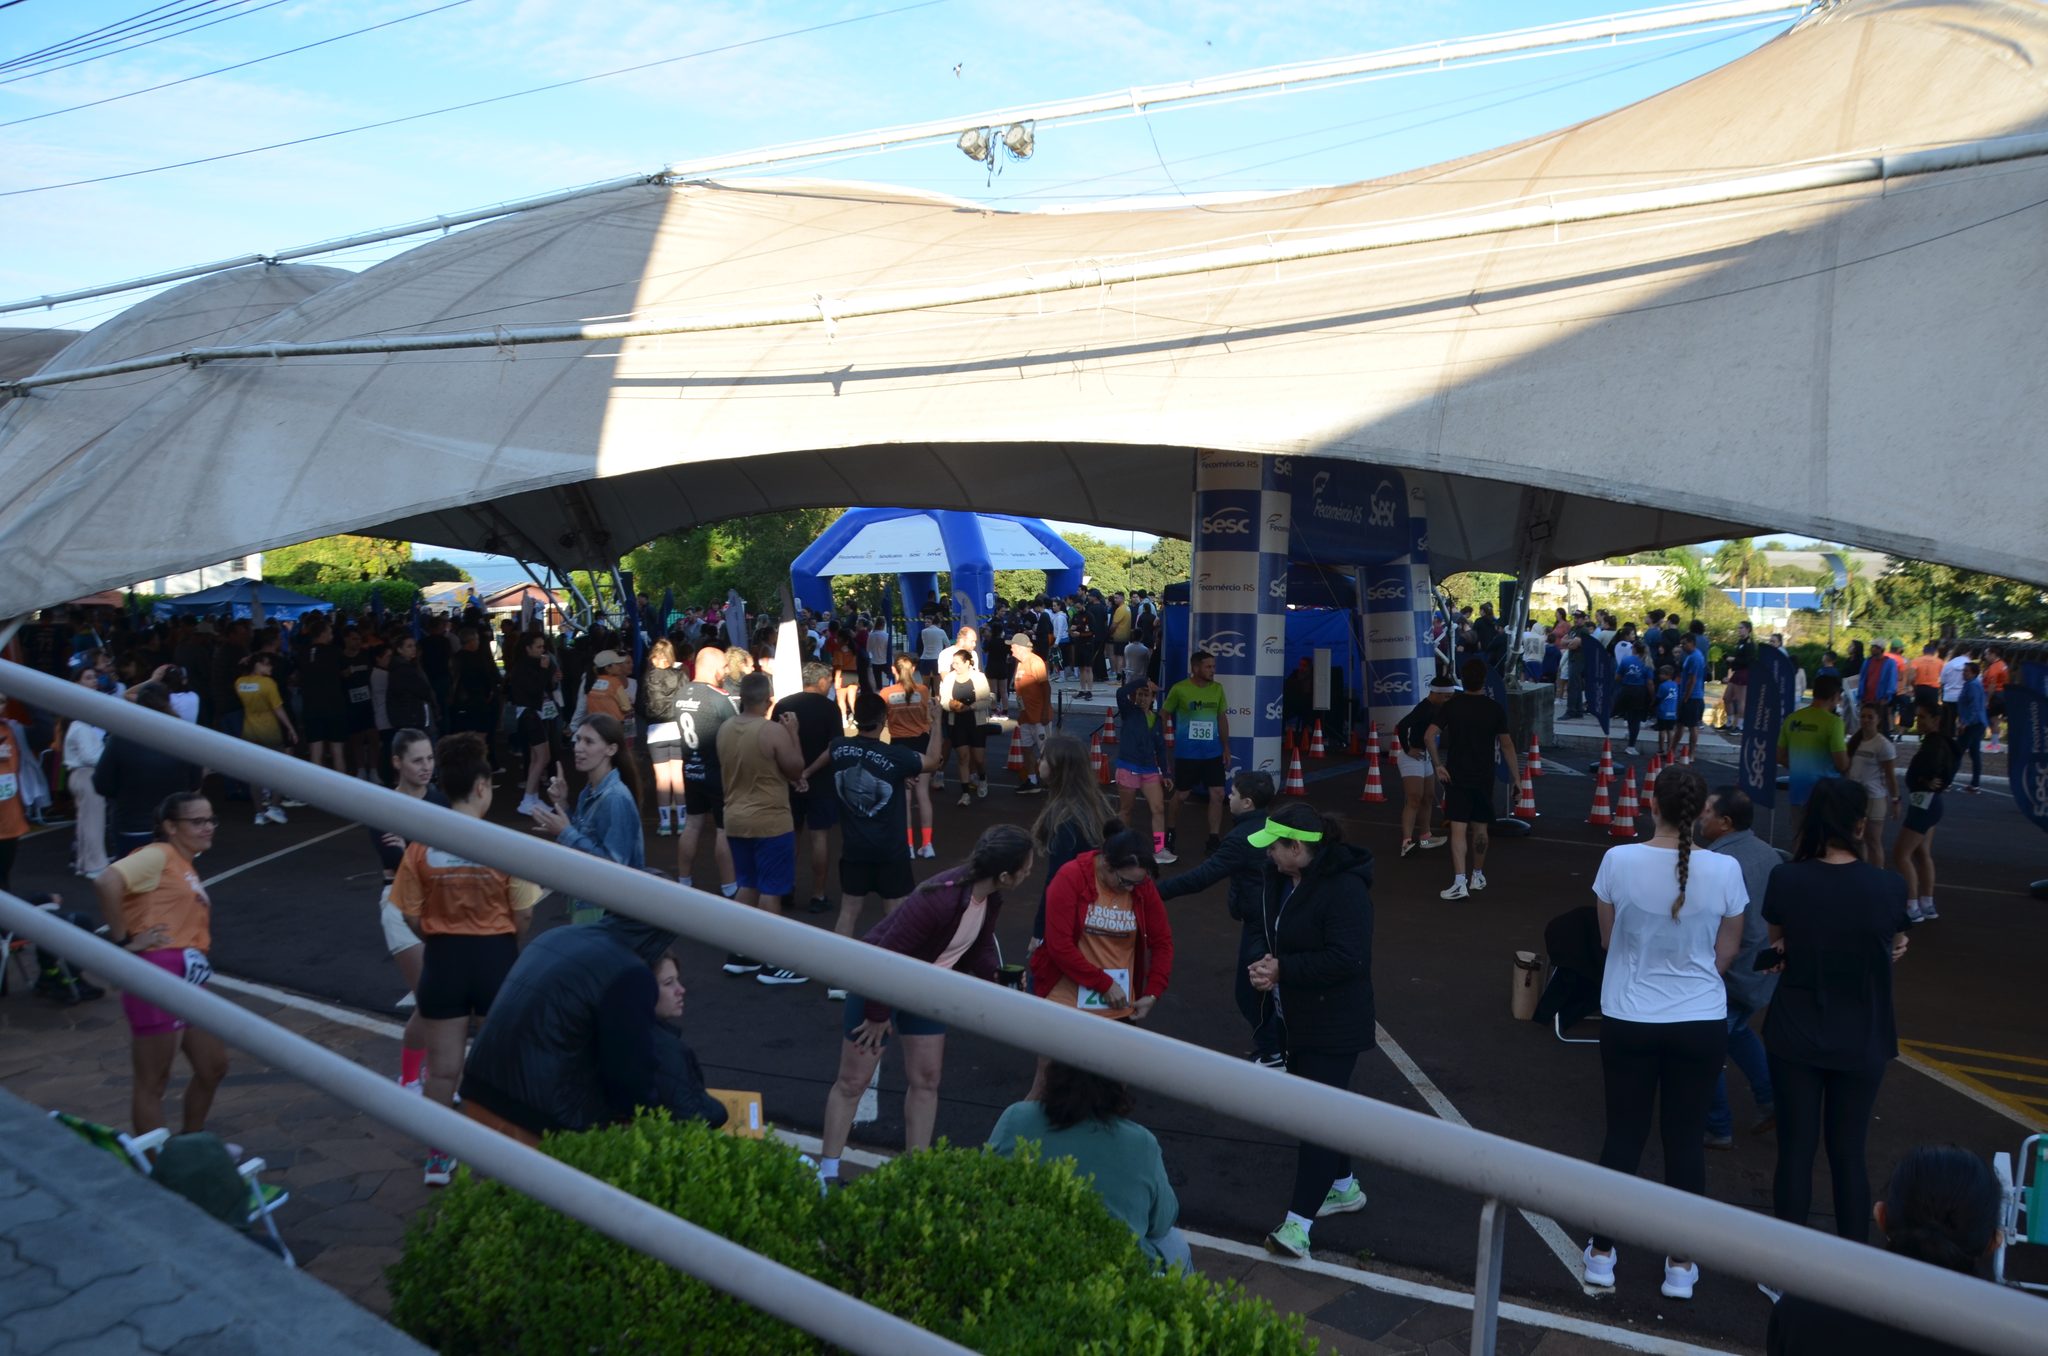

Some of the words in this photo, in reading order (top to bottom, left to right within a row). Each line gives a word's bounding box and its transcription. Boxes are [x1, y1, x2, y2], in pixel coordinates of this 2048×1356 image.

[1247, 460, 1259, 469] RS
[1313, 498, 1353, 521] Fecomércio
[1352, 505, 1363, 524] RS
[1243, 583, 1255, 592] RS
[680, 712, 699, 749] 8
[1192, 728, 1211, 738] 336
[865, 750, 895, 771] FIGHT
